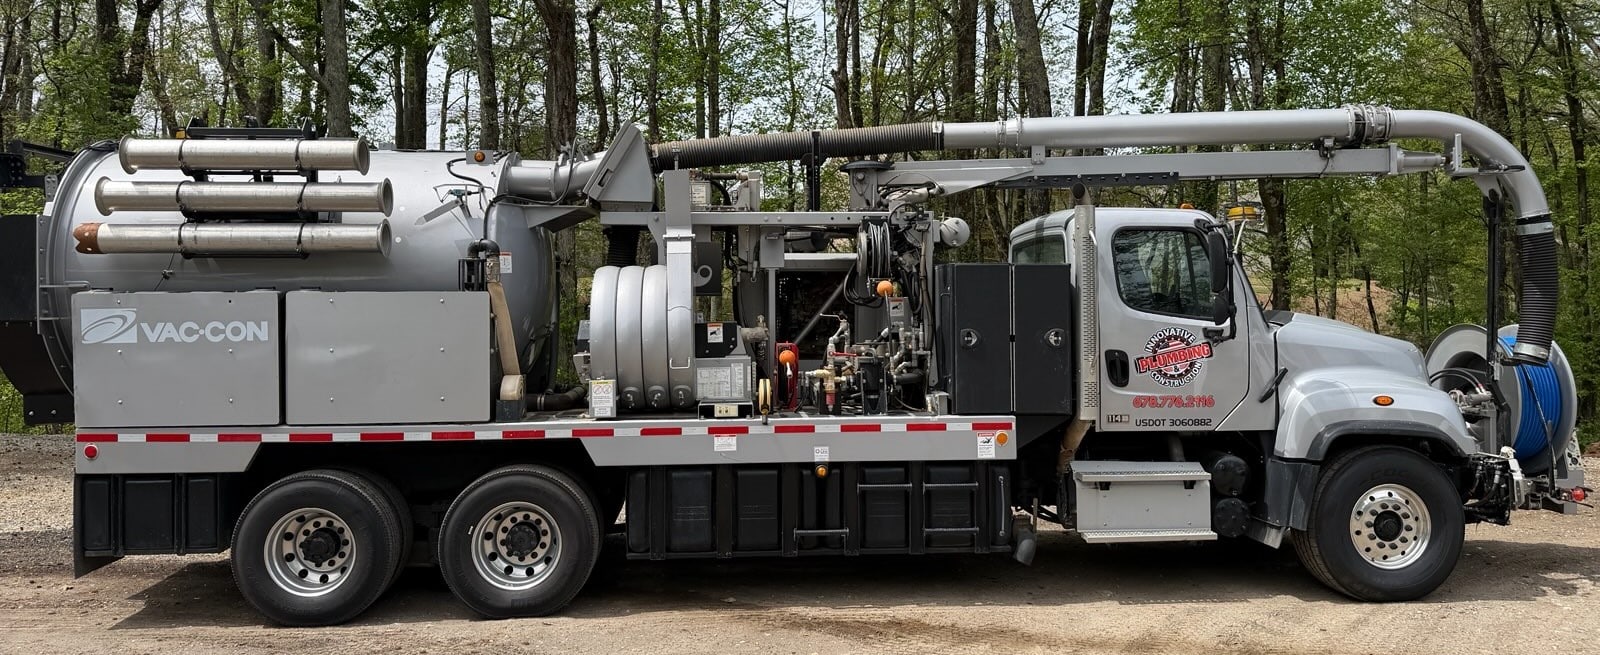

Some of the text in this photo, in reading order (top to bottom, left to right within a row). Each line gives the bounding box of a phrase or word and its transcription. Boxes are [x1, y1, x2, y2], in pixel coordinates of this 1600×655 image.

[1144, 327, 1197, 353] INNOVATIVE
[1138, 343, 1211, 373] PLUMBING
[1173, 365, 1180, 373] &
[1150, 361, 1203, 387] CONSTRUCTION
[1135, 418, 1167, 427] USDOT
[1169, 418, 1213, 427] 3060882
